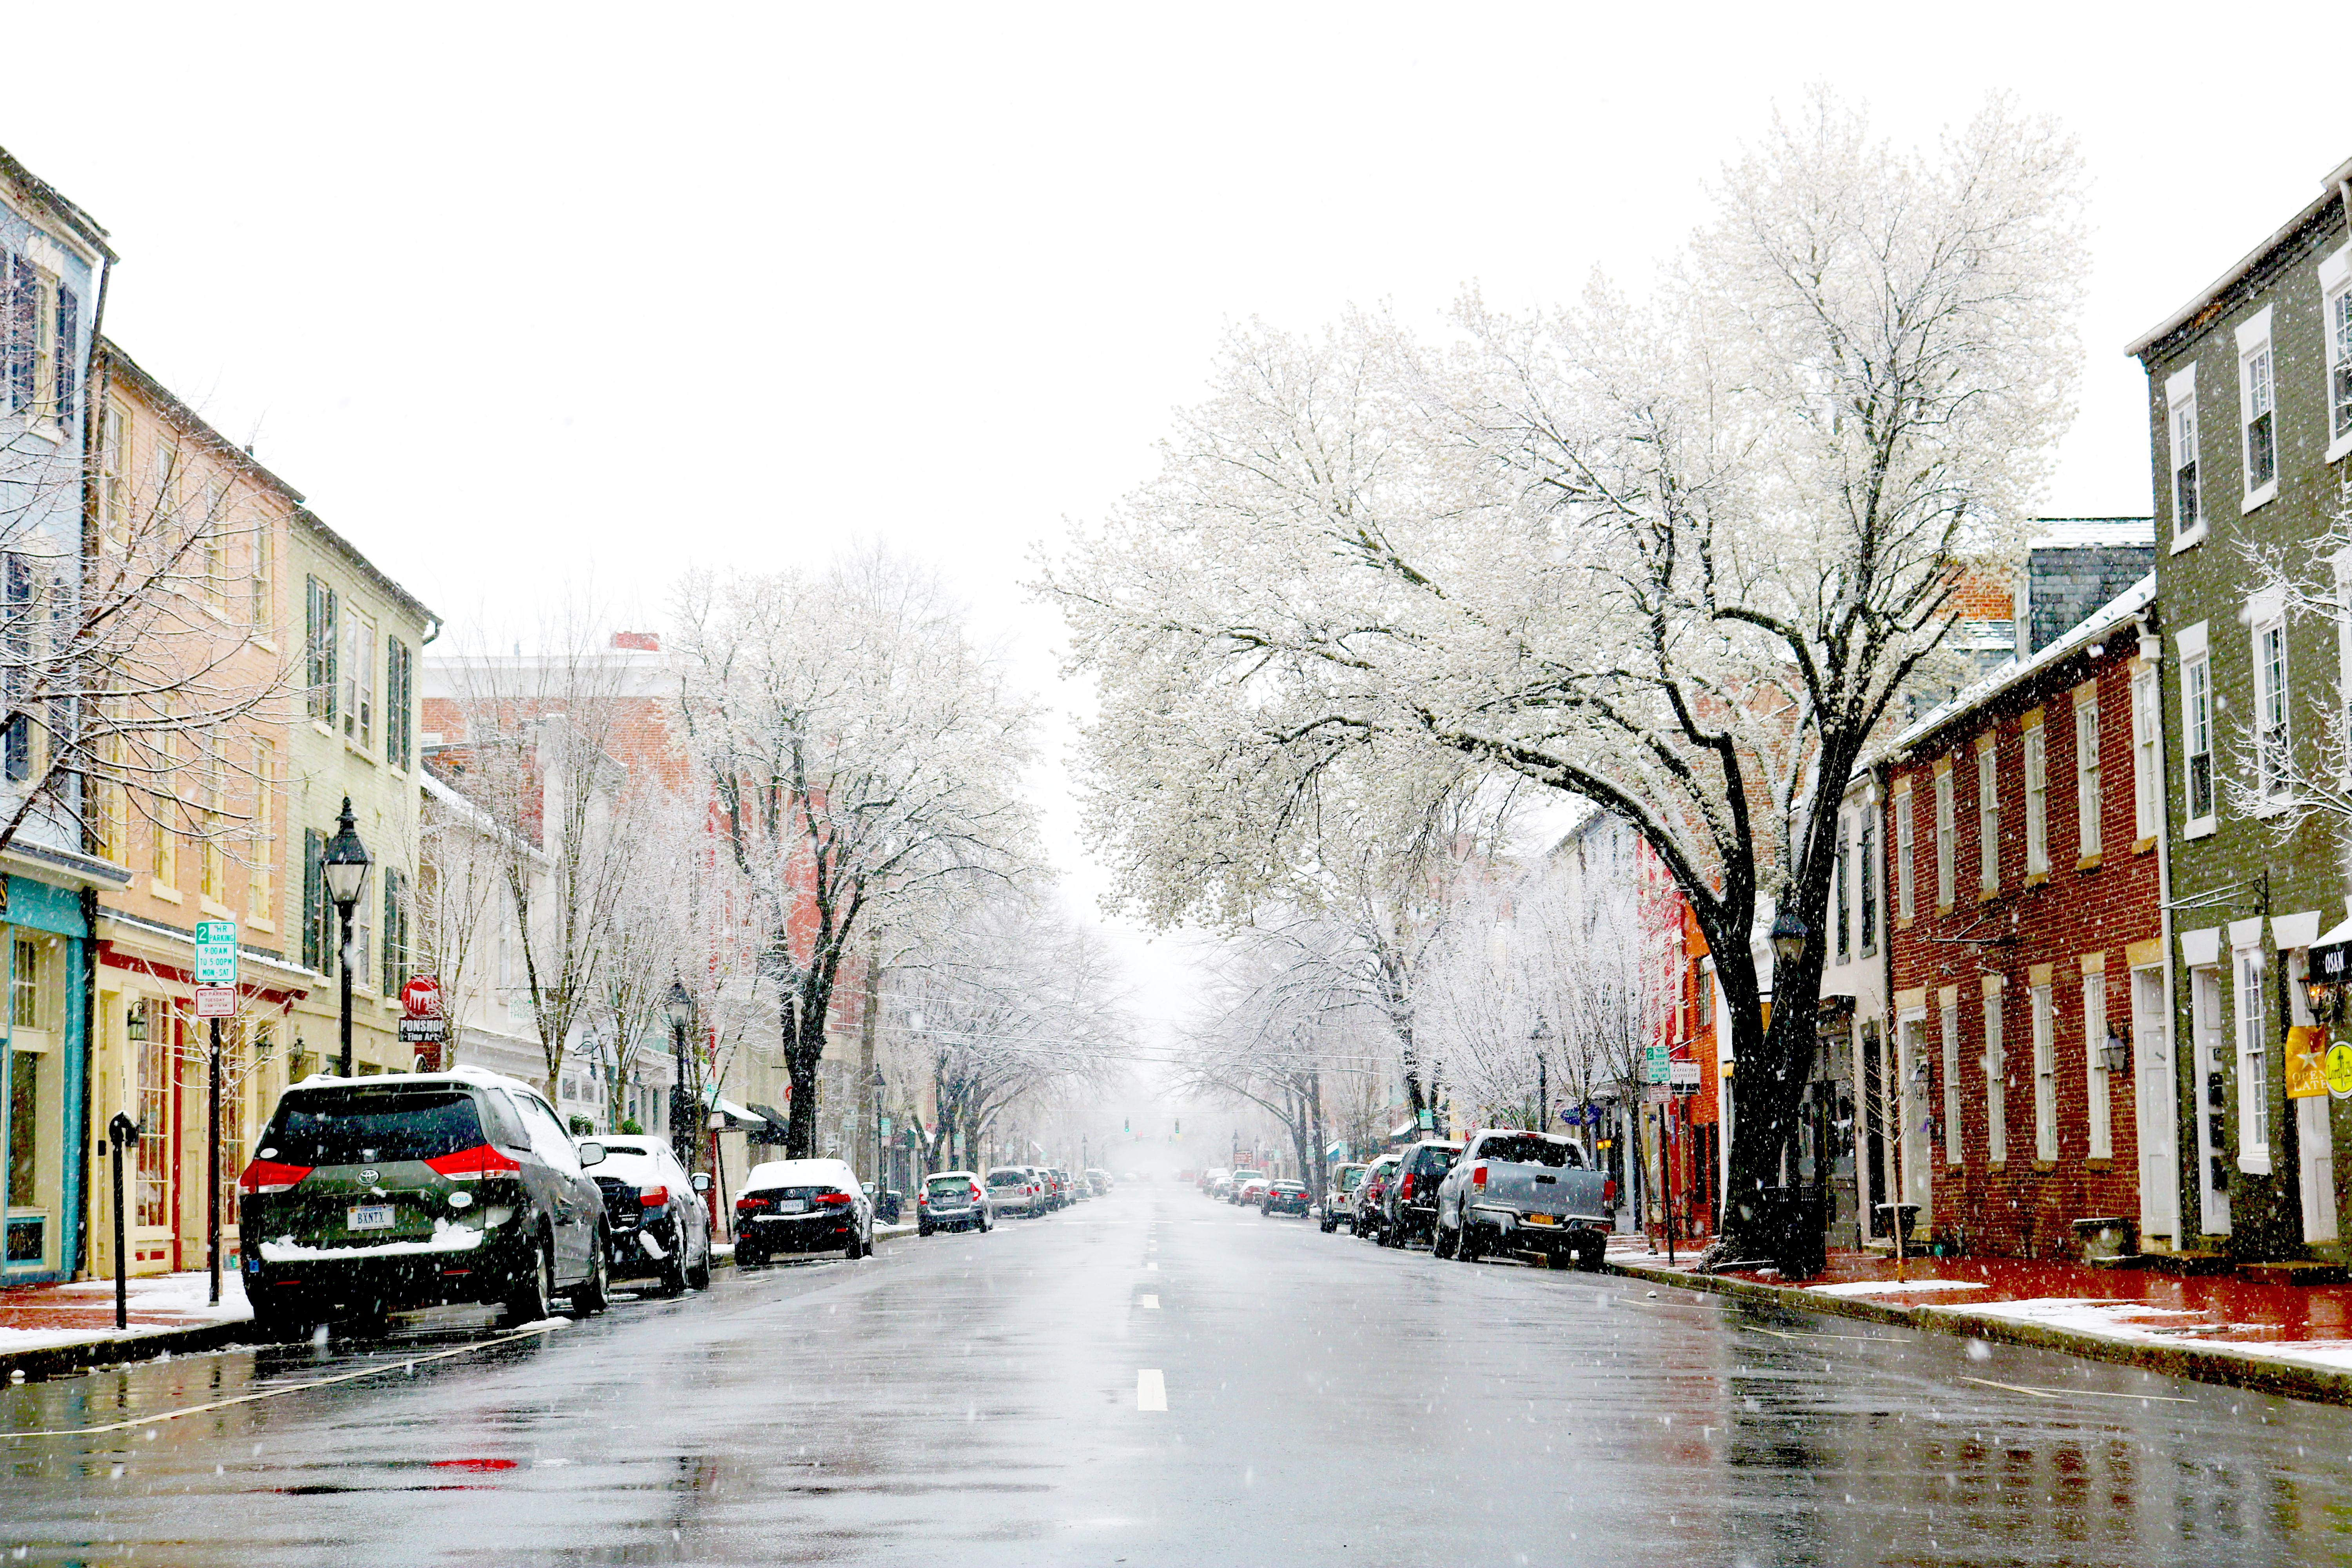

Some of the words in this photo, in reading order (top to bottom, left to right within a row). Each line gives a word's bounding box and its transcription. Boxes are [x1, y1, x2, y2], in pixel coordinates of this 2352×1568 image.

[199, 927, 207, 940] 2
[400, 1020, 445, 1032] PONSHOP
[408, 1033, 423, 1041] Fine
[2292, 1070, 2326, 1082] OPEN
[2294, 1079, 2327, 1092] LATE
[358, 1212, 384, 1224] BXNTX
